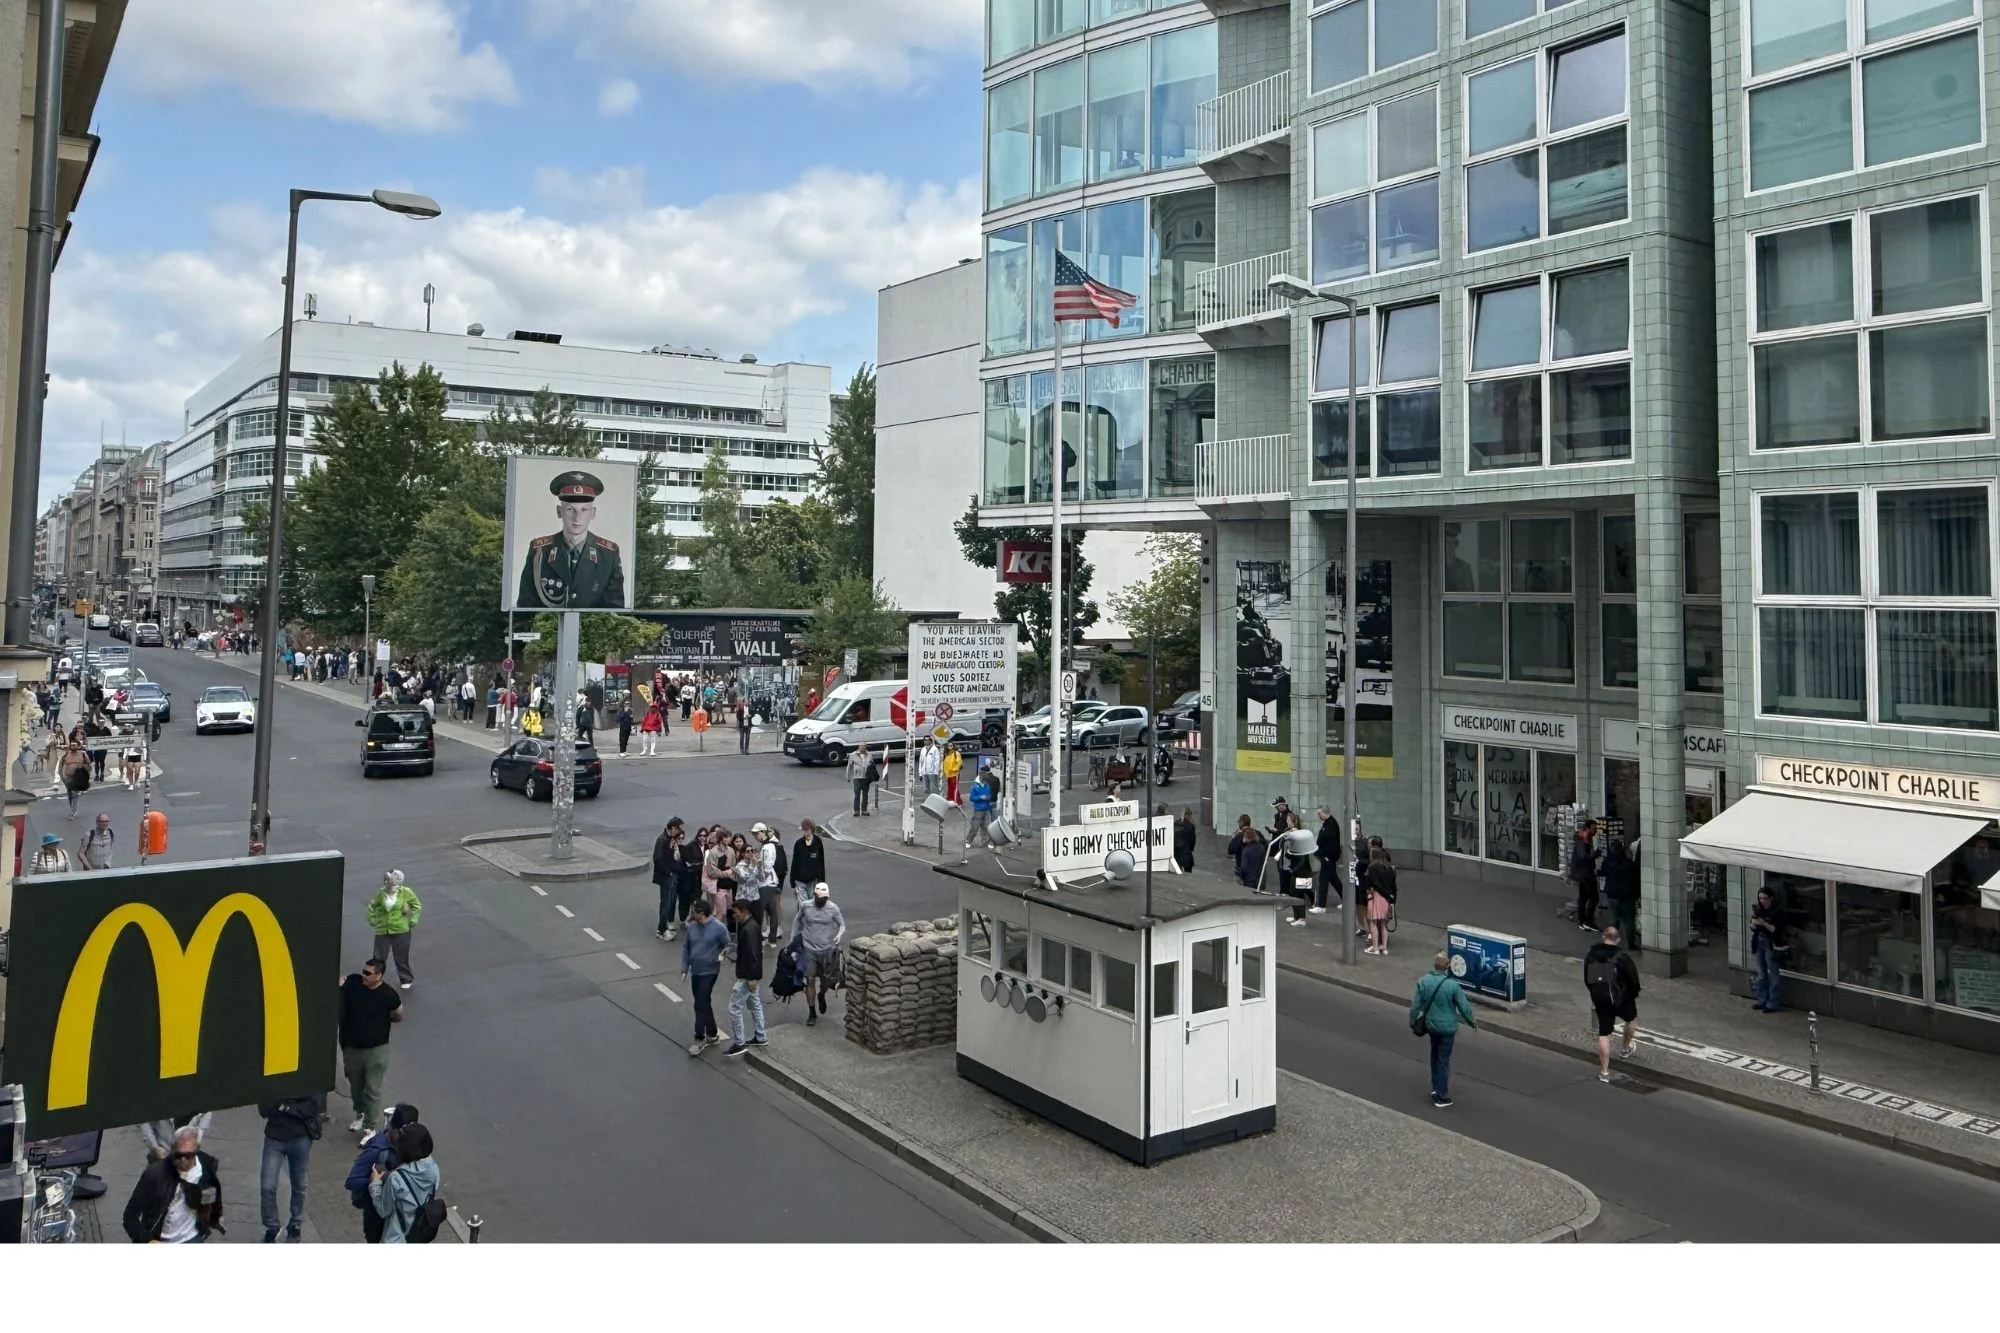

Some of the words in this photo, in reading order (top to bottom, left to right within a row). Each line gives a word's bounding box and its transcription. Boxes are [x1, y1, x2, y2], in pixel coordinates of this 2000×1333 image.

[1159, 362, 1215, 385] CHARLIE
[673, 630, 713, 640] GUERRE
[928, 626, 944, 635] YOU
[948, 626, 964, 635] ARE
[968, 625, 1001, 635] LEAVING
[922, 637, 936, 646] THE
[939, 637, 976, 646] AMERICAN
[979, 636, 1005, 645] SECTOR
[733, 640, 780, 657] WALL
[932, 673, 955, 682] VOUS
[960, 673, 990, 682] SORTEZ
[933, 685, 965, 694] SECTEUR
[1201, 695, 1211, 706] 45
[1247, 725, 1277, 736] MAUER
[1454, 714, 1516, 735] CHECKPOINT
[1519, 720, 1565, 738] CHARLIE
[1247, 735, 1277, 745] MUSEUM
[1780, 762, 1890, 792] CHECKPOINT
[1898, 774, 1980, 802] CHARLIE
[1073, 834, 1103, 856] ARMY
[1106, 827, 1167, 852] CHECKPINT
